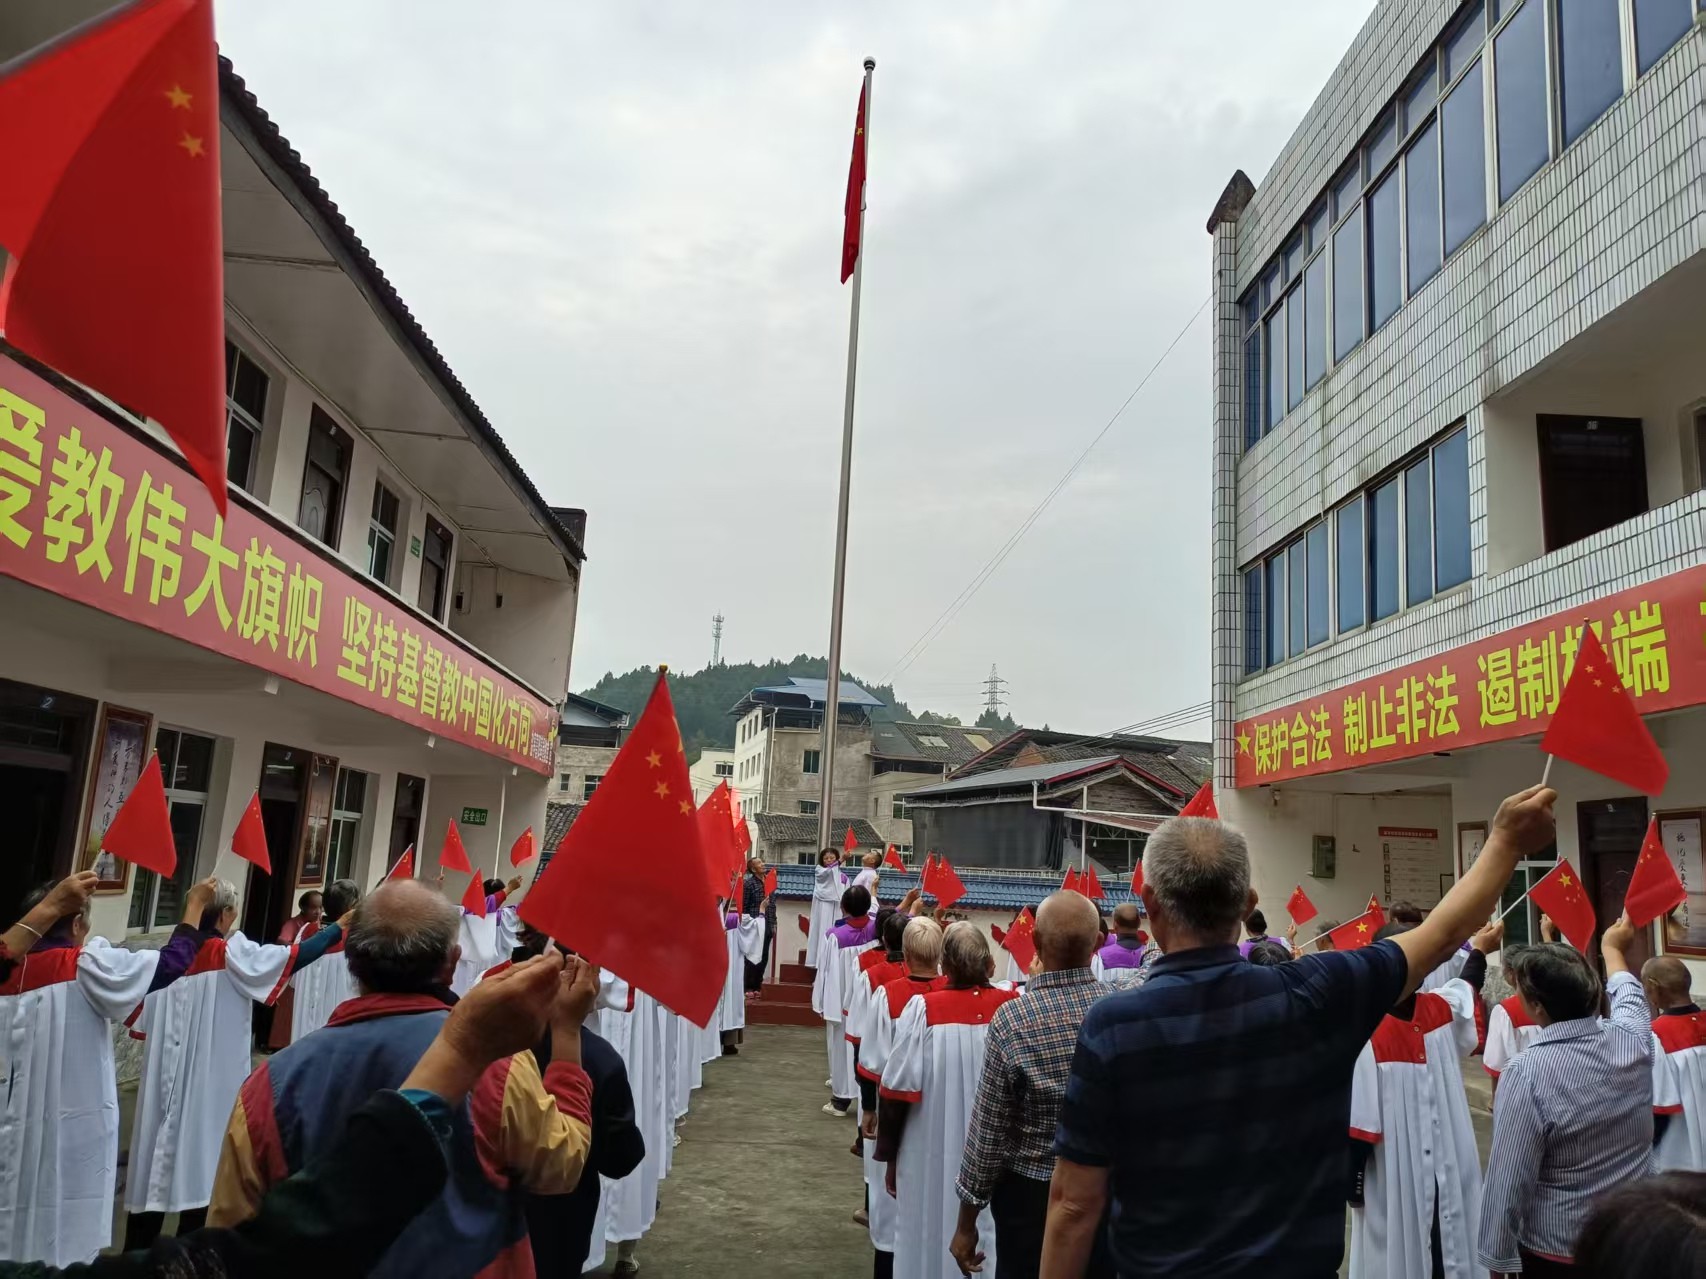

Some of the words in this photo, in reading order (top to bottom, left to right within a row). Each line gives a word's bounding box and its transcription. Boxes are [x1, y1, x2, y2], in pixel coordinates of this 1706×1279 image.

[337, 596, 531, 756] 坚持基督教中国化方向
[1254, 704, 1332, 775] 保护合法
[1344, 665, 1460, 756] 制止非法
[463, 810, 486, 823] 安全出口
